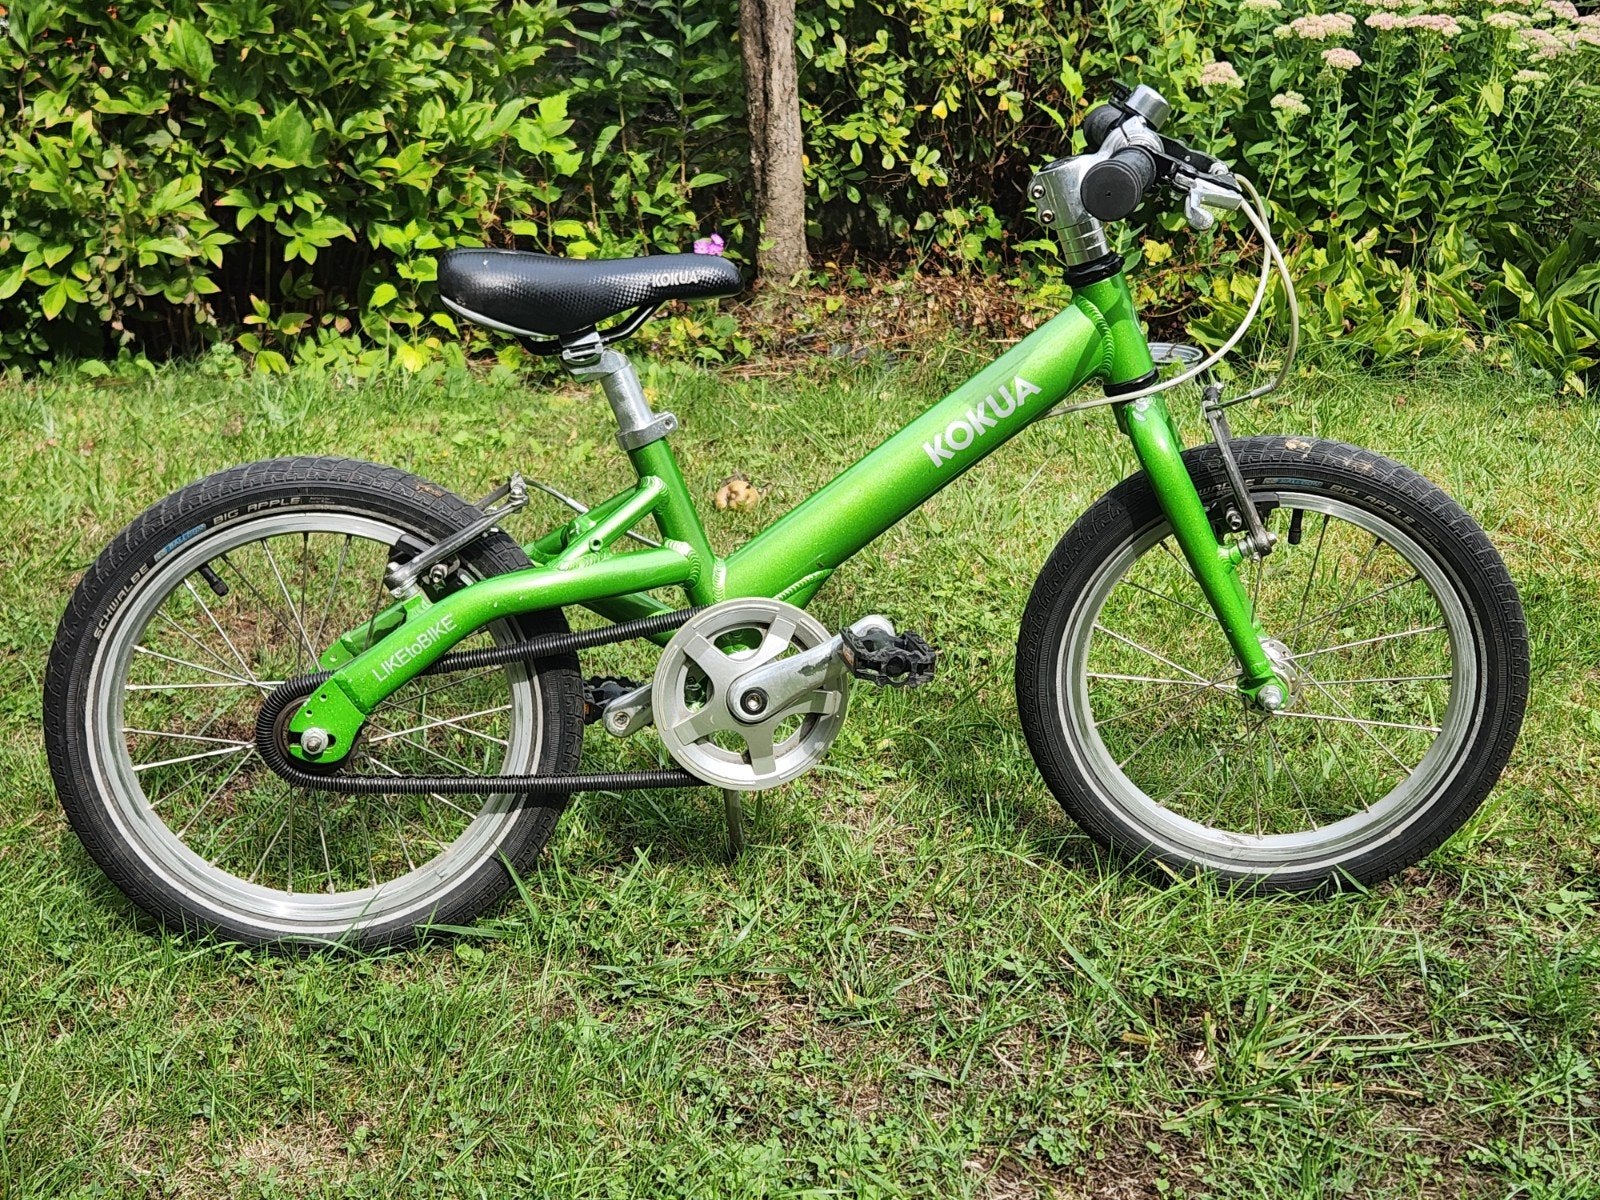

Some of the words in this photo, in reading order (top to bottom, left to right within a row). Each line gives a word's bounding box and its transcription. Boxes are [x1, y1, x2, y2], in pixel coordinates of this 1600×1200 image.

[652, 271, 699, 287] KOKUA
[922, 375, 1042, 468] KOKUA
[1329, 484, 1359, 496] BIG
[1363, 495, 1416, 524] APPLE
[93, 563, 150, 639] SCHWALBE
[213, 509, 239, 525] BIG
[247, 497, 301, 512] APPLE
[371, 613, 457, 682] LIKEtoBIKE
